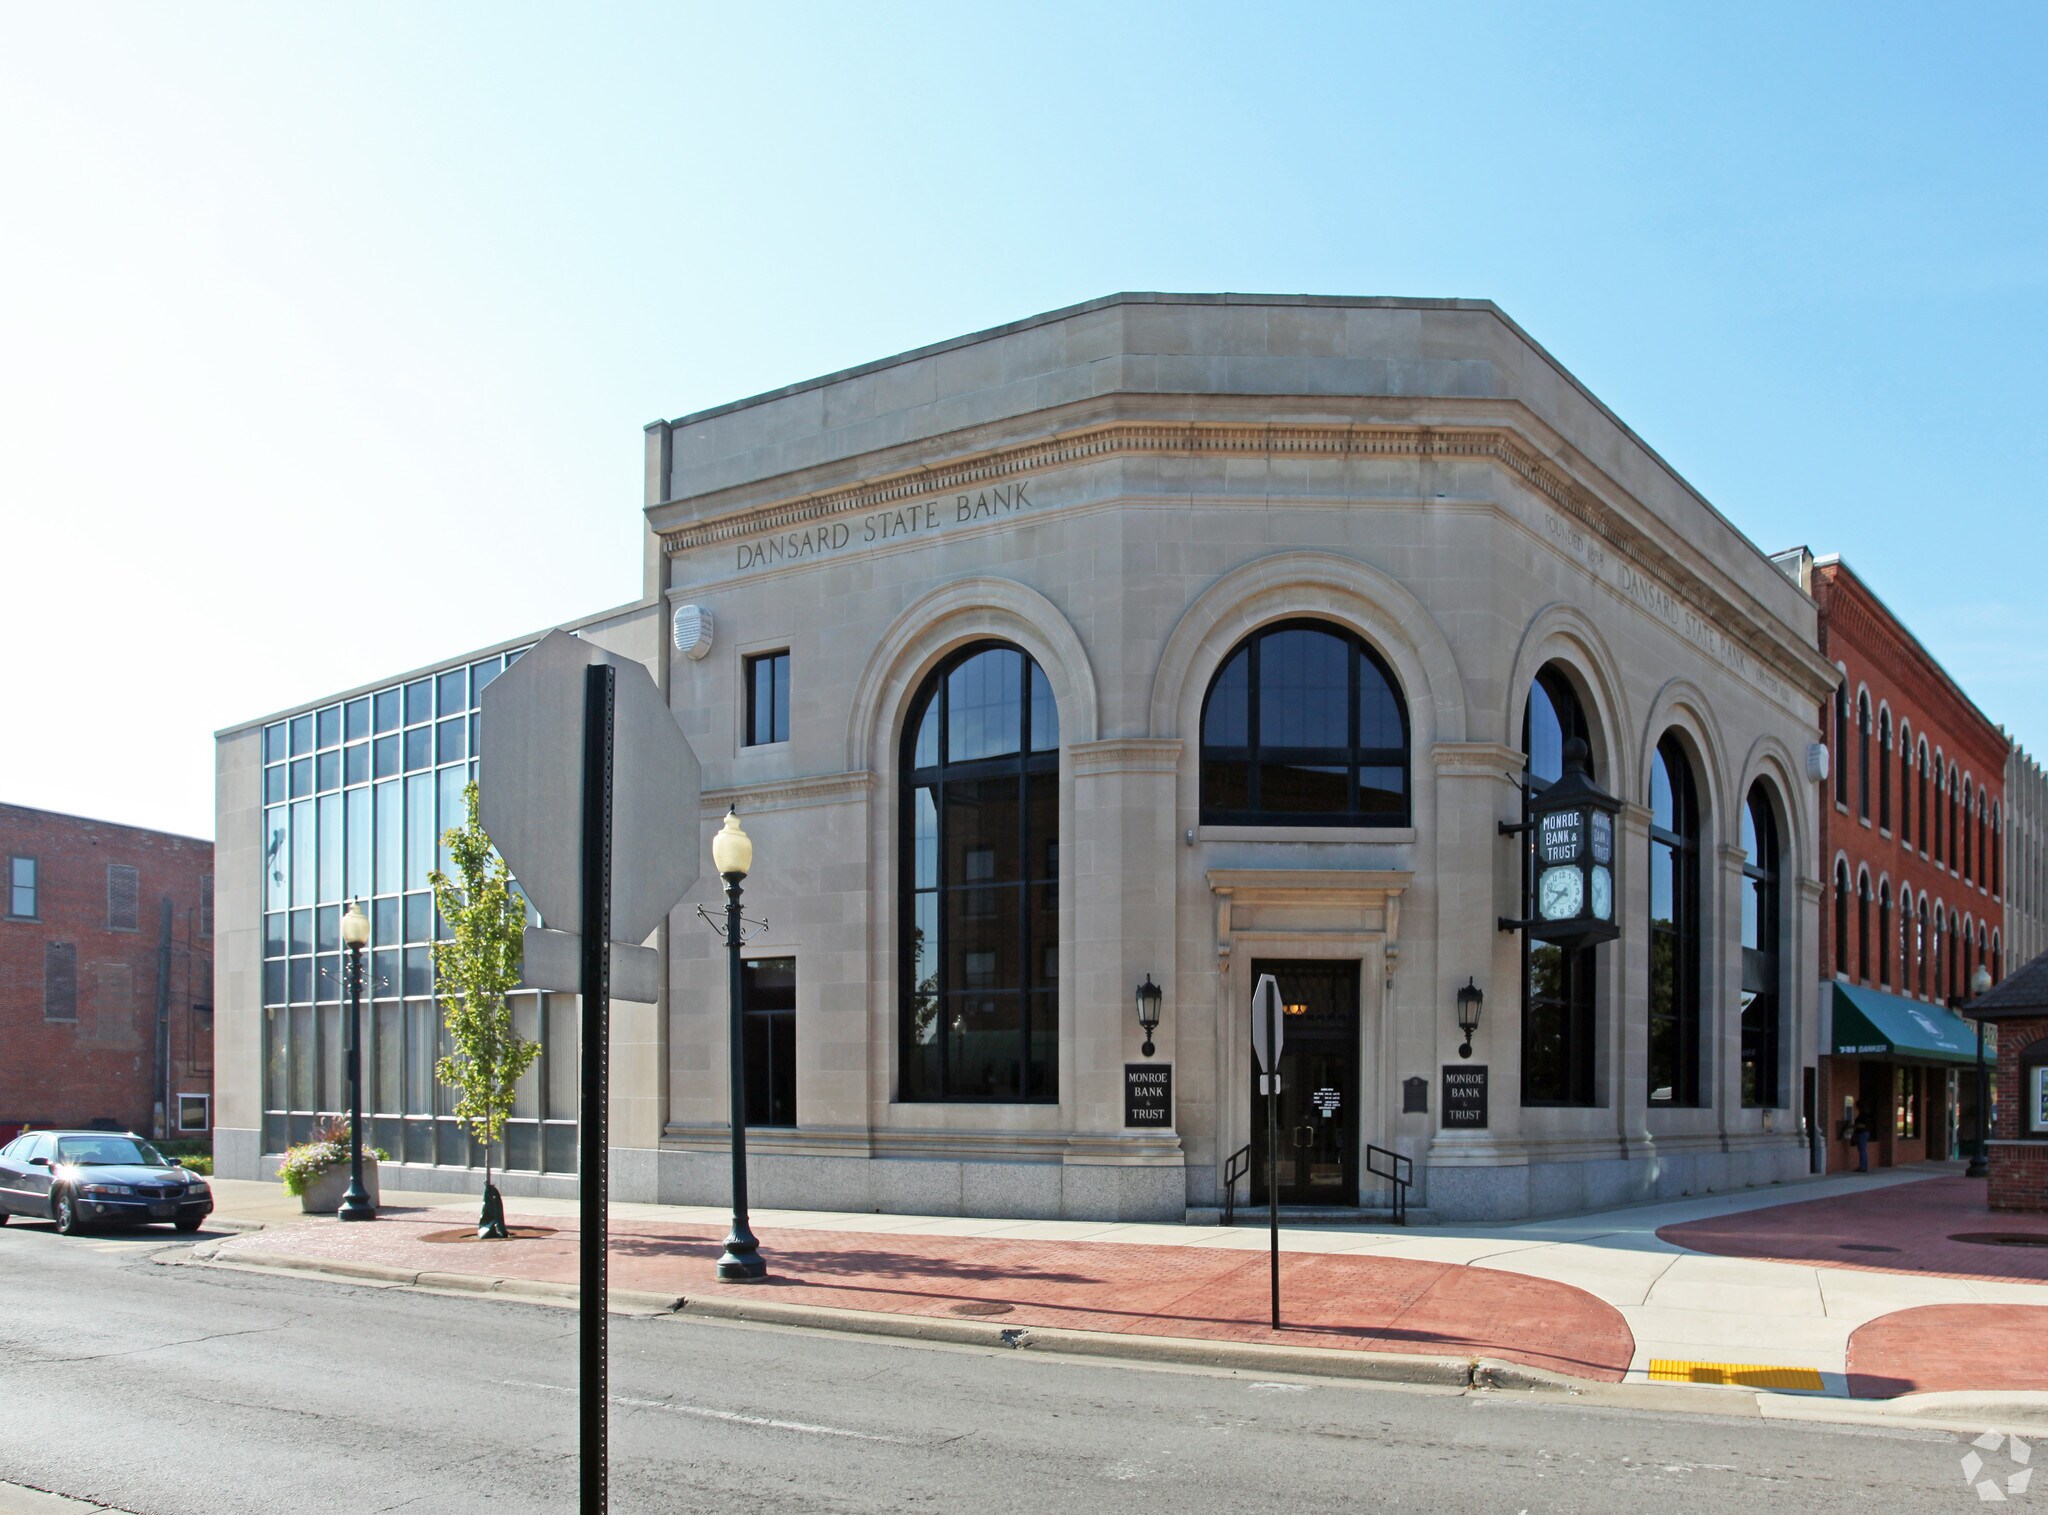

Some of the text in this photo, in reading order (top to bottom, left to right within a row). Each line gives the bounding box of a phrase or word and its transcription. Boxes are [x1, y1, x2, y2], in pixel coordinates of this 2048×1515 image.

[736, 480, 1033, 571] DANSARD STATE BANK
[1545, 512, 1584, 553] FOUNDED
[1621, 564, 1747, 675] DANSARD STATE BANK
[1542, 811, 1580, 831] MONROE
[1545, 829, 1578, 846] BANK &
[1547, 844, 1577, 860] TRUST
[1128, 1072, 1168, 1083] MONROE
[1446, 1073, 1484, 1084] MONROE
[1134, 1086, 1163, 1097] BANK
[1451, 1087, 1480, 1098] BANK
[1132, 1109, 1165, 1119] TRUST
[1449, 1110, 1481, 1120] TRUST
